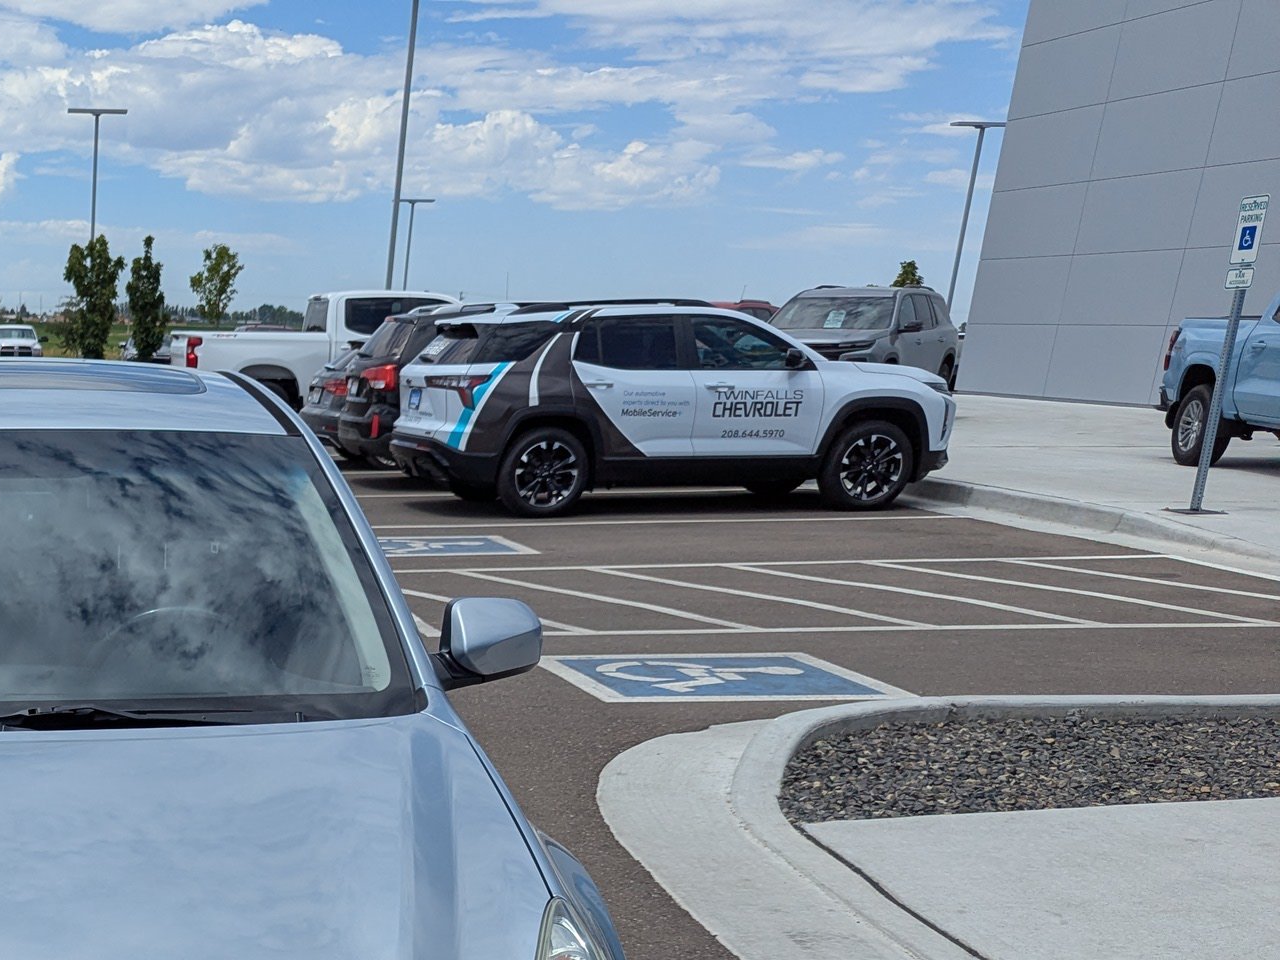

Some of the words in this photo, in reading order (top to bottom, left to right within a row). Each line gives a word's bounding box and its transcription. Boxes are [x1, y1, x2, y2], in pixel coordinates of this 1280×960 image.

[1240, 213, 1264, 223] PARKING
[712, 401, 803, 418] CHEVROLET
[721, 429, 785, 439] 208.644.5970
